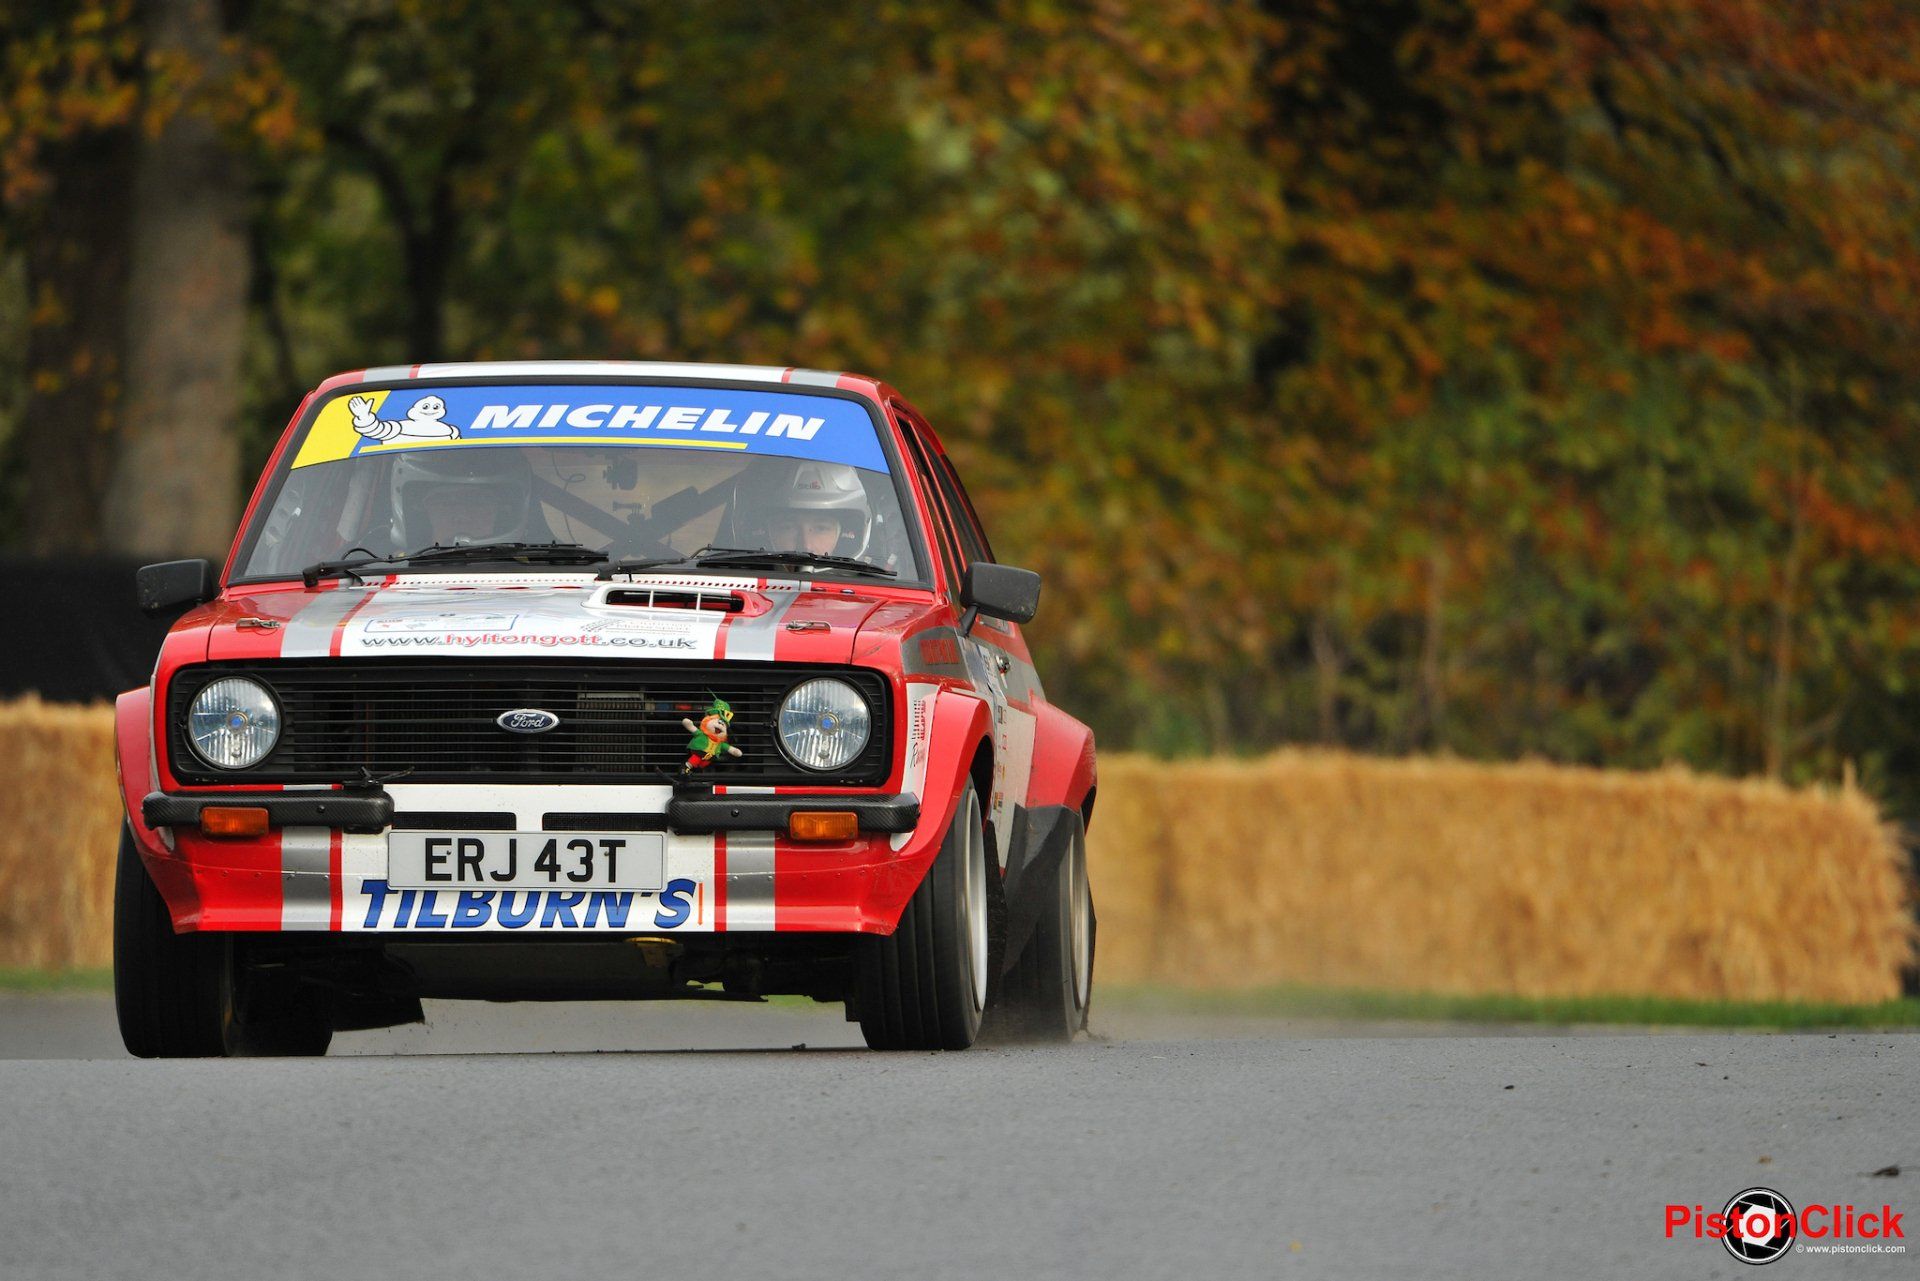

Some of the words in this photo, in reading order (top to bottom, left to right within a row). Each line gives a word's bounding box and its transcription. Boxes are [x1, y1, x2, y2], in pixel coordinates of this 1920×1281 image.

[470, 403, 825, 441] MICHELIN
[361, 633, 697, 649] www.hyltongott.co.uk
[511, 713, 546, 728] Ford
[425, 837, 517, 882] ERJ
[534, 838, 626, 882] 43T
[360, 878, 697, 929] TILBURNS
